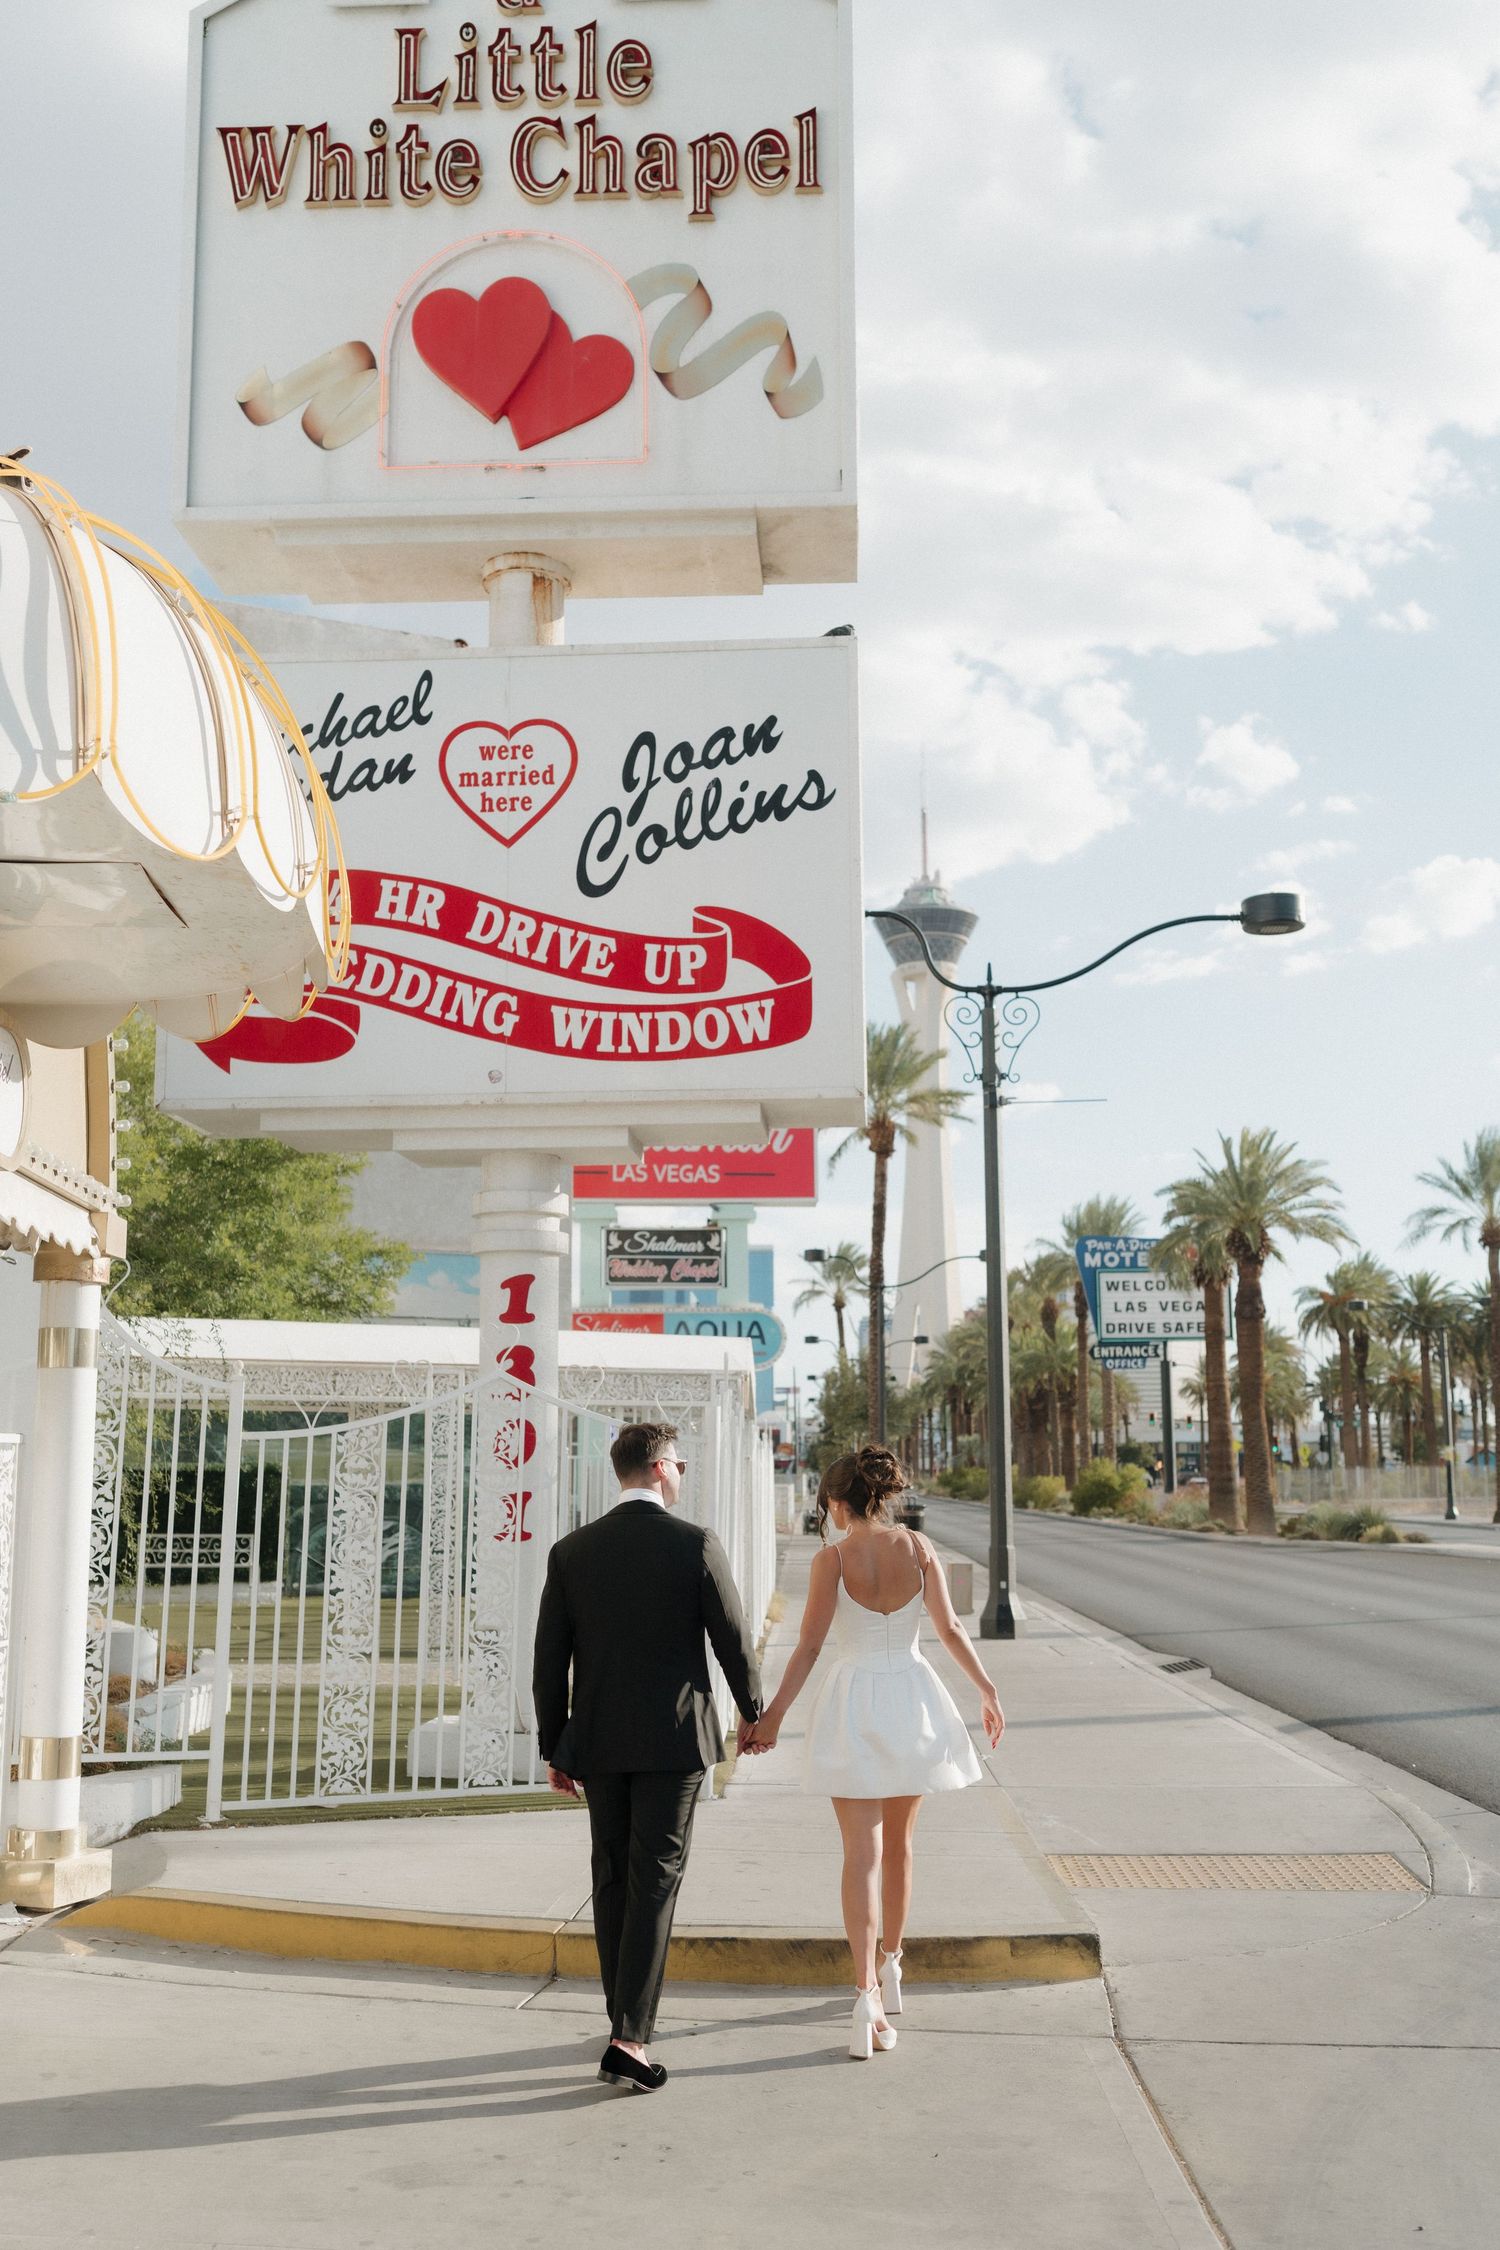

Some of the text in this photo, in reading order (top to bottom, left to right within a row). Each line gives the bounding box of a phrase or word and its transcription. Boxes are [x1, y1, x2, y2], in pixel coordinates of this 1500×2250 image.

[392, 20, 654, 113] Little
[216, 106, 824, 223] White Chapel
[479, 744, 533, 761] were
[459, 764, 555, 787] married
[621, 714, 783, 827] Joan
[480, 791, 532, 813] here
[576, 769, 836, 898] Collins
[374, 878, 446, 930] HR
[465, 900, 617, 978] DRIVE
[644, 943, 707, 986] UP
[550, 998, 775, 1054] WINDOW
[611, 1164, 720, 1184] LAS VEGAS
[623, 1231, 705, 1254] Shalimar
[1114, 1301, 1147, 1313] LAS
[1106, 1322, 1156, 1334] DRIVE
[1093, 1345, 1156, 1359] ENTRANCE
[1105, 1358, 1147, 1369] OFFICE
